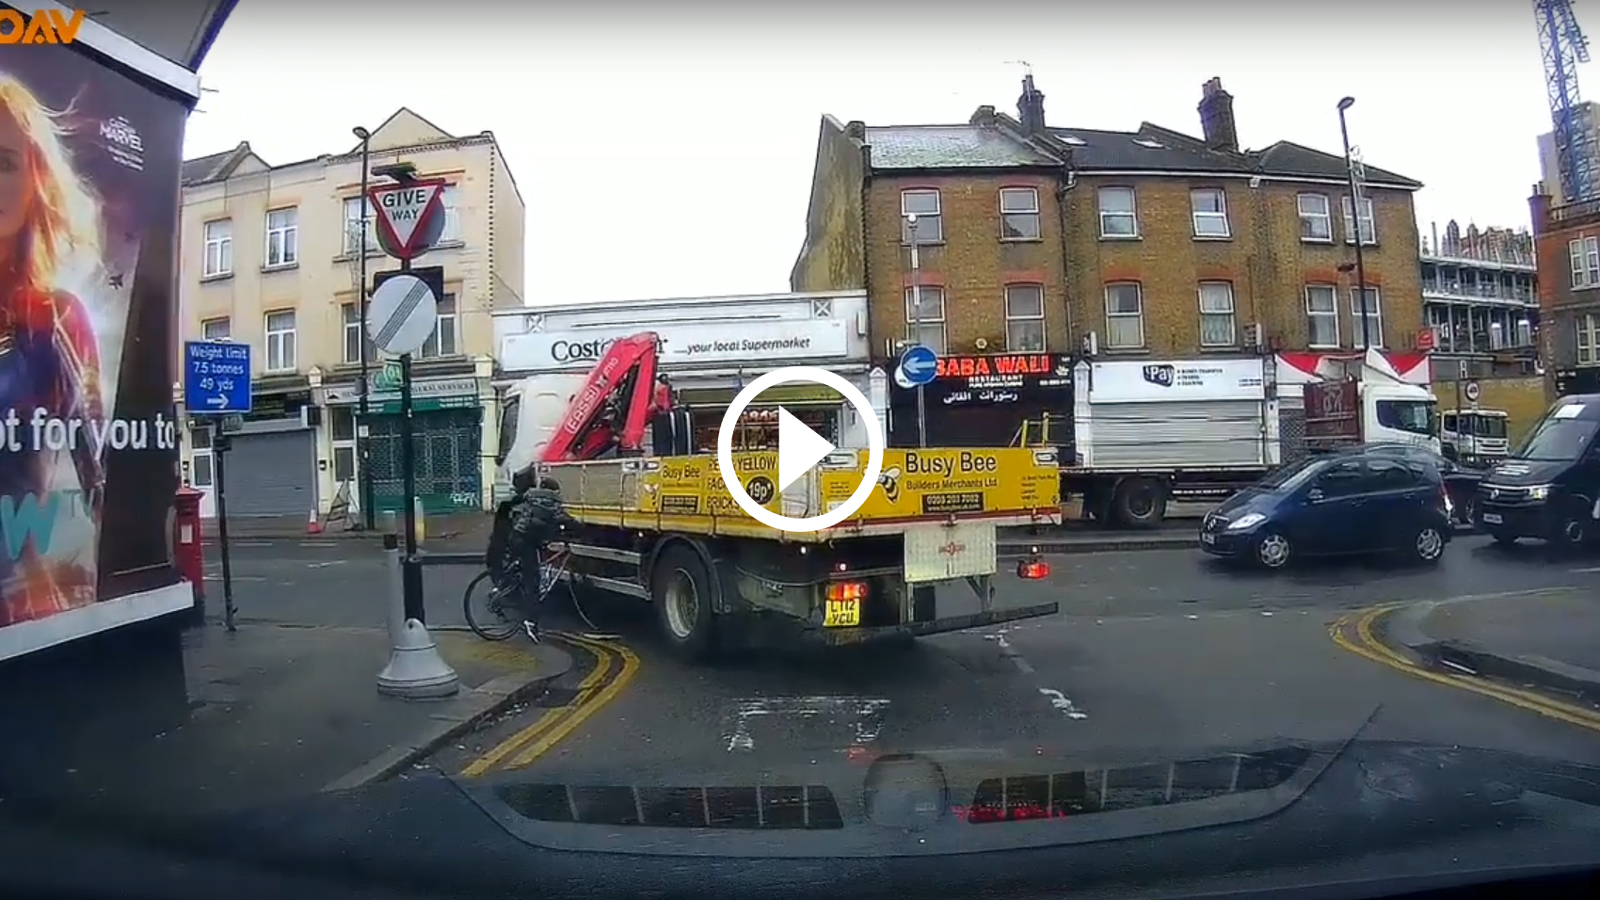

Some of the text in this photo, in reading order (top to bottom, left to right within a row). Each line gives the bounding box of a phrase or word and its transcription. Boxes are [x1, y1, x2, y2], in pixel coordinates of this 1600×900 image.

[100, 121, 144, 152] MARVEL
[383, 189, 426, 208] GIVE
[391, 209, 419, 221] WAY
[713, 341, 739, 351] local
[742, 337, 810, 351] Supermarket
[190, 345, 223, 360] Weight
[211, 363, 244, 375] tonnes
[994, 355, 1050, 374] WALI
[199, 377, 235, 392] 49 yds
[31, 407, 83, 451] for
[91, 419, 147, 462] you
[737, 456, 777, 471] YELLOW
[905, 451, 997, 478] Busy Bee
[662, 465, 700, 481] Busy Bee
[906, 477, 998, 491] Builders Merchants Ltd
